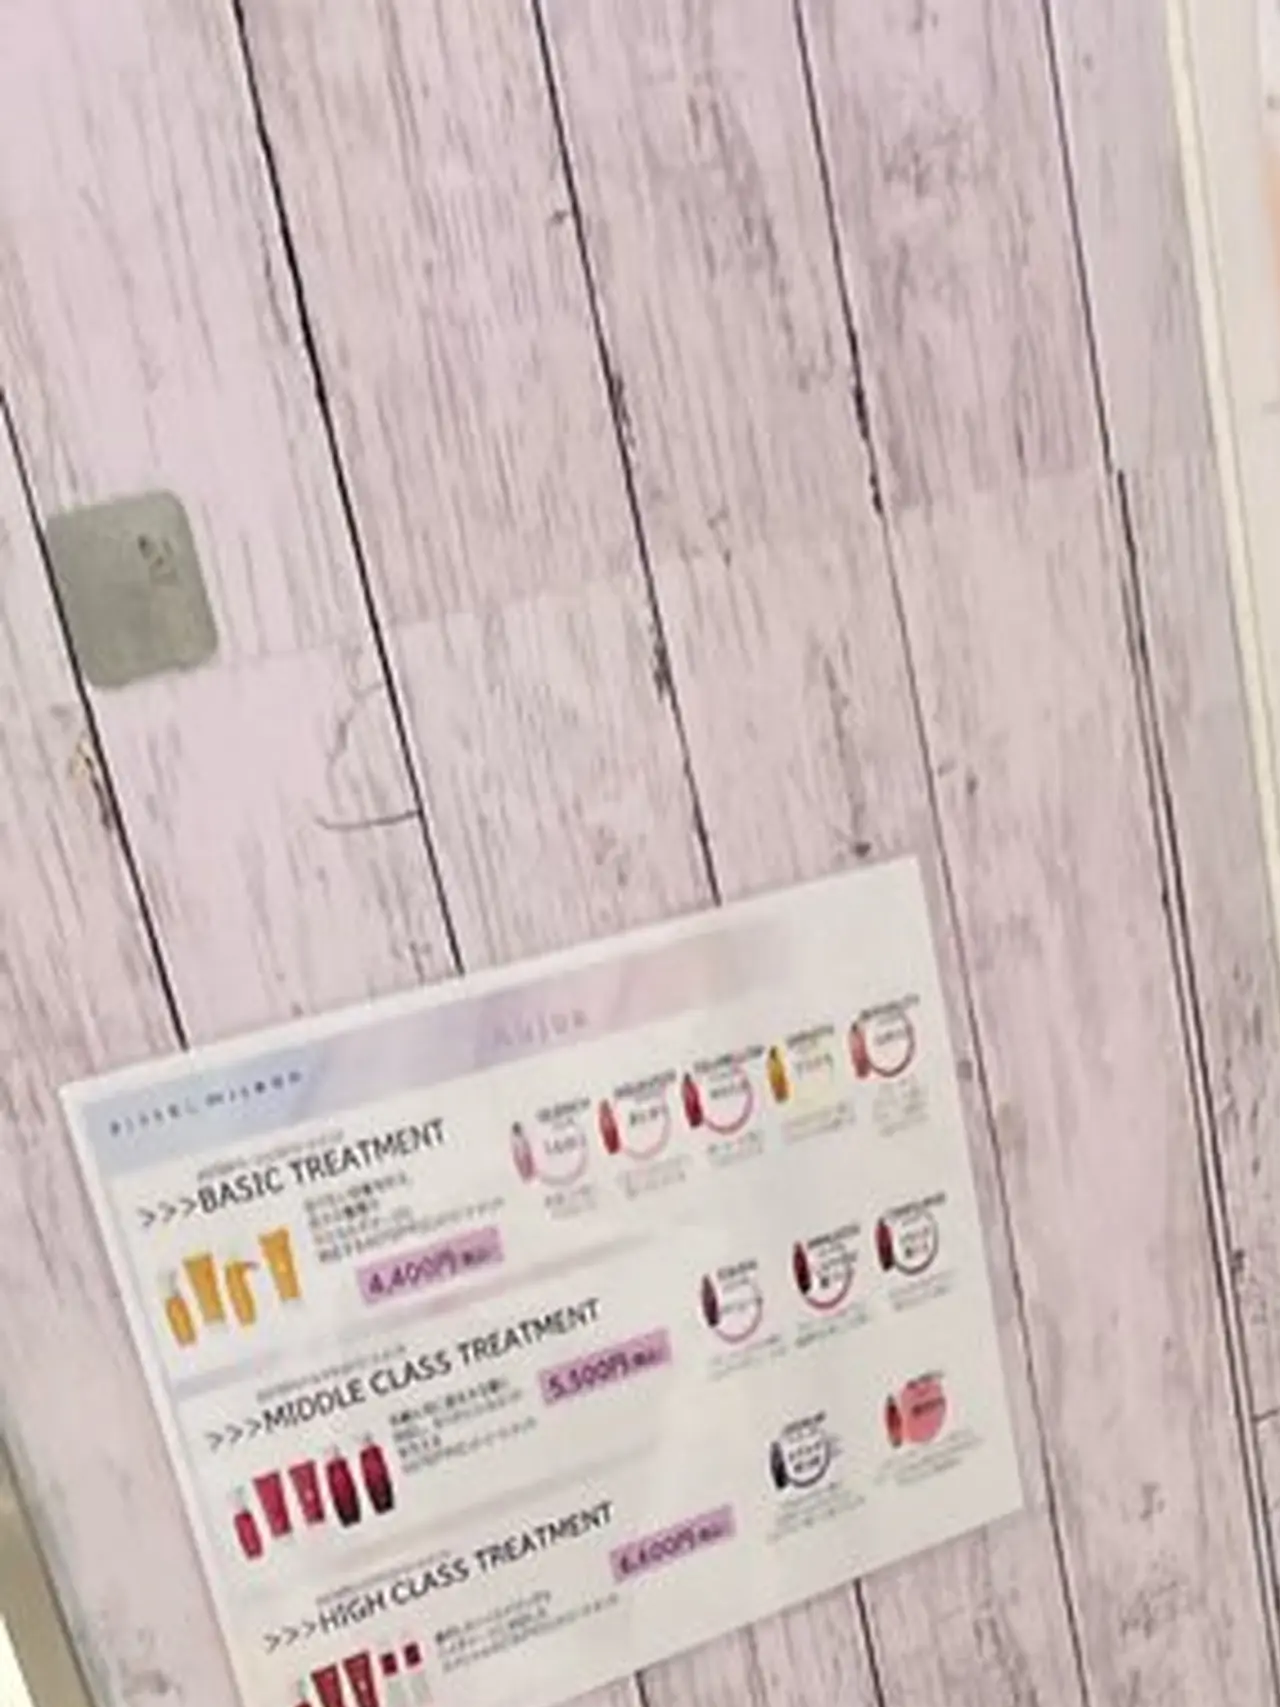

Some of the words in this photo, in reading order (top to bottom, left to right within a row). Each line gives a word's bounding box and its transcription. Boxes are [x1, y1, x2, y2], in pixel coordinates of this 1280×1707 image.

[289, 1117, 445, 1185] TREATMENT
[369, 1350, 453, 1395] CLASS
[457, 1299, 601, 1366] TREATMENT
[390, 1557, 470, 1604] CLASS
[474, 1501, 613, 1576] TREATMENT
